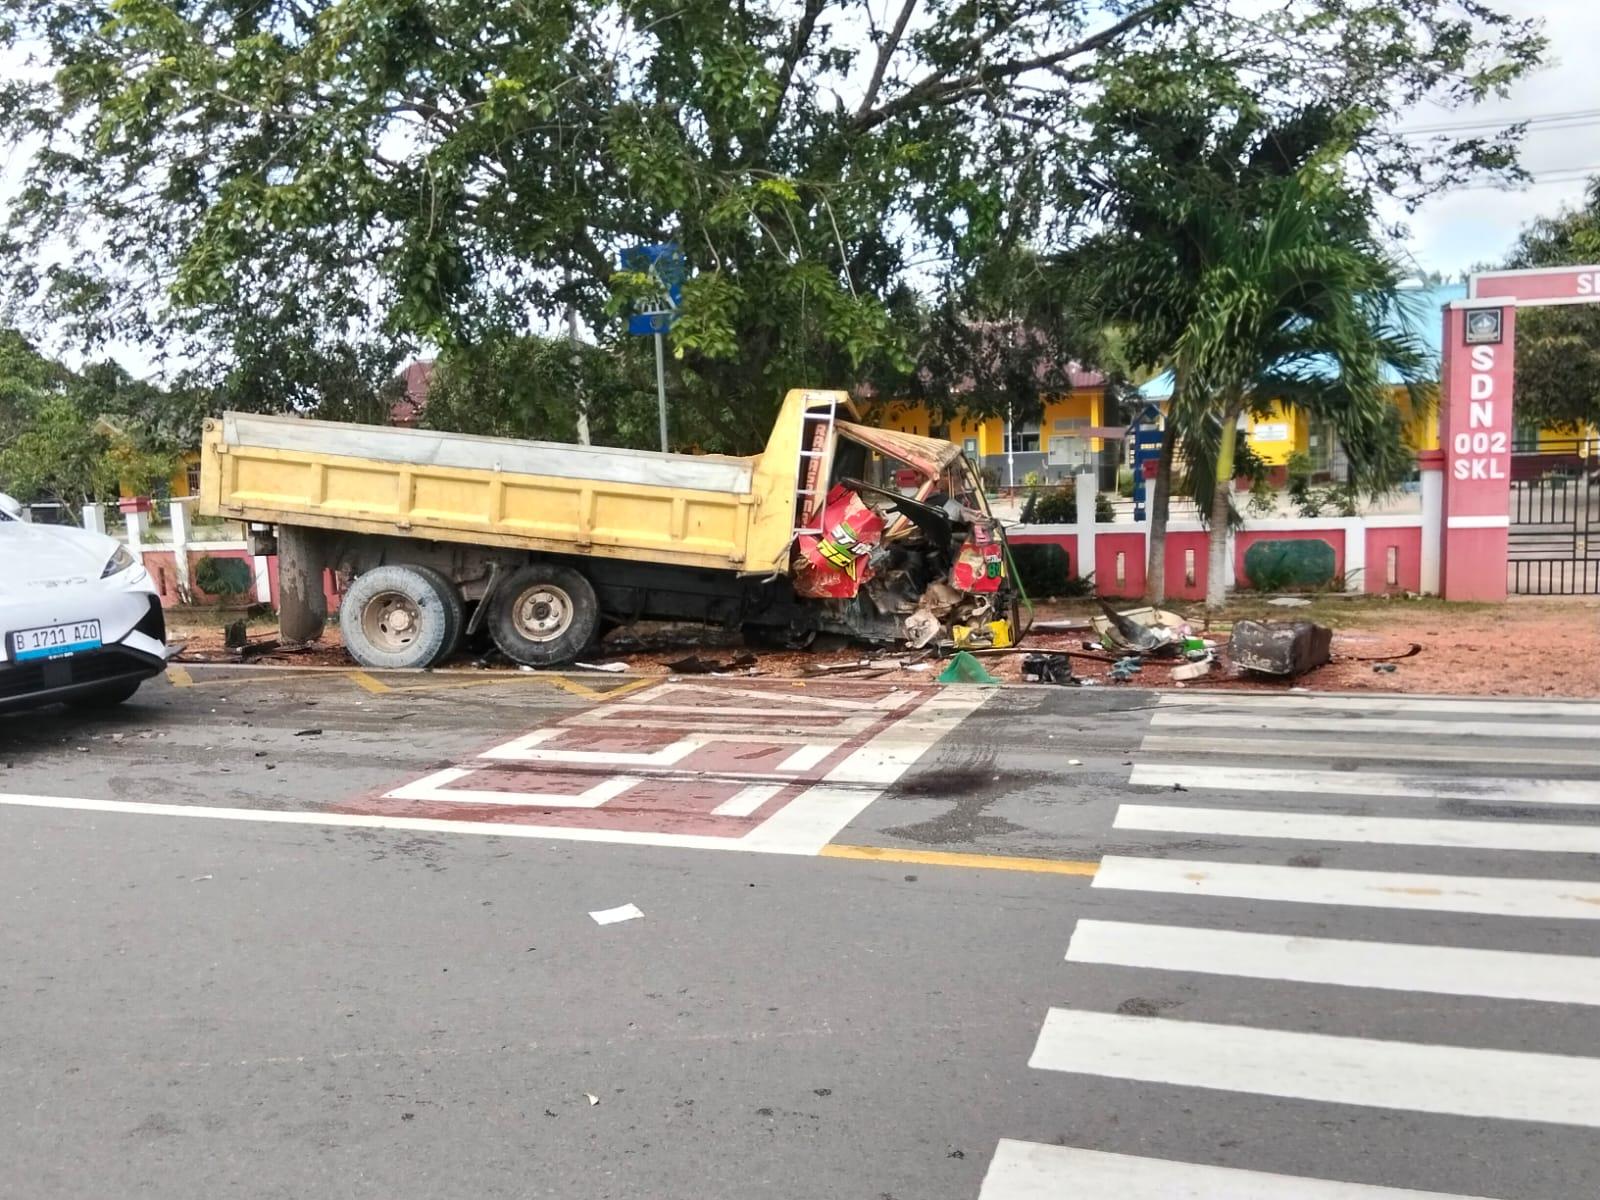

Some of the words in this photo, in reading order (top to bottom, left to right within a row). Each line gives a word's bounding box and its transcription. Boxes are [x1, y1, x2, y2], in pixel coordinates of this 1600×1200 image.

[1470, 344, 1495, 428] SDN
[1454, 432, 1507, 454] 002
[1454, 458, 1505, 480] SKL
[16, 634, 25, 650] B
[32, 628, 67, 648] 1711
[74, 624, 98, 640] AZO
